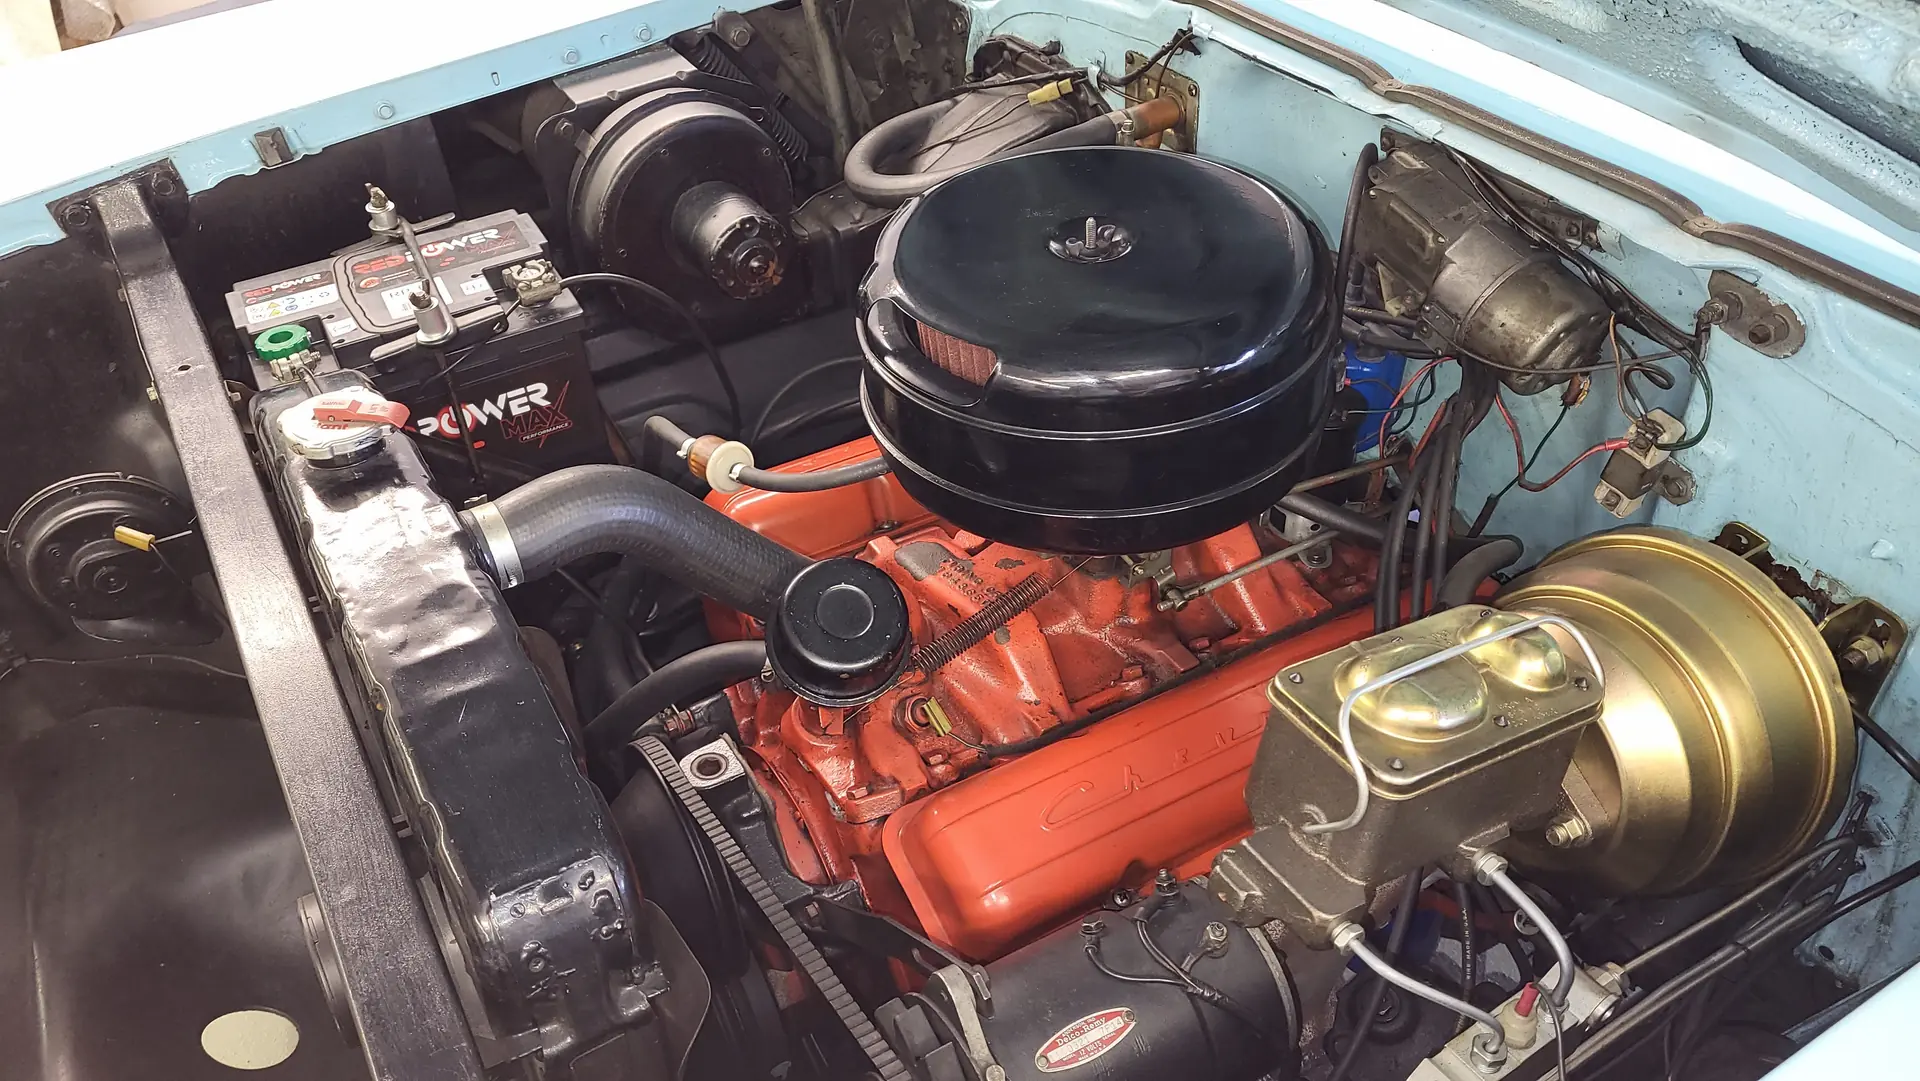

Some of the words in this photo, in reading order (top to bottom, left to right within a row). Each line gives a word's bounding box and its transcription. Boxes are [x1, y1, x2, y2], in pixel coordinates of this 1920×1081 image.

[501, 380, 569, 439] MAX
[522, 422, 569, 441] PERFORMANCE
[1055, 1017, 1106, 1046] Delco-Remy
[1086, 1041, 1102, 1053] VOLTS
